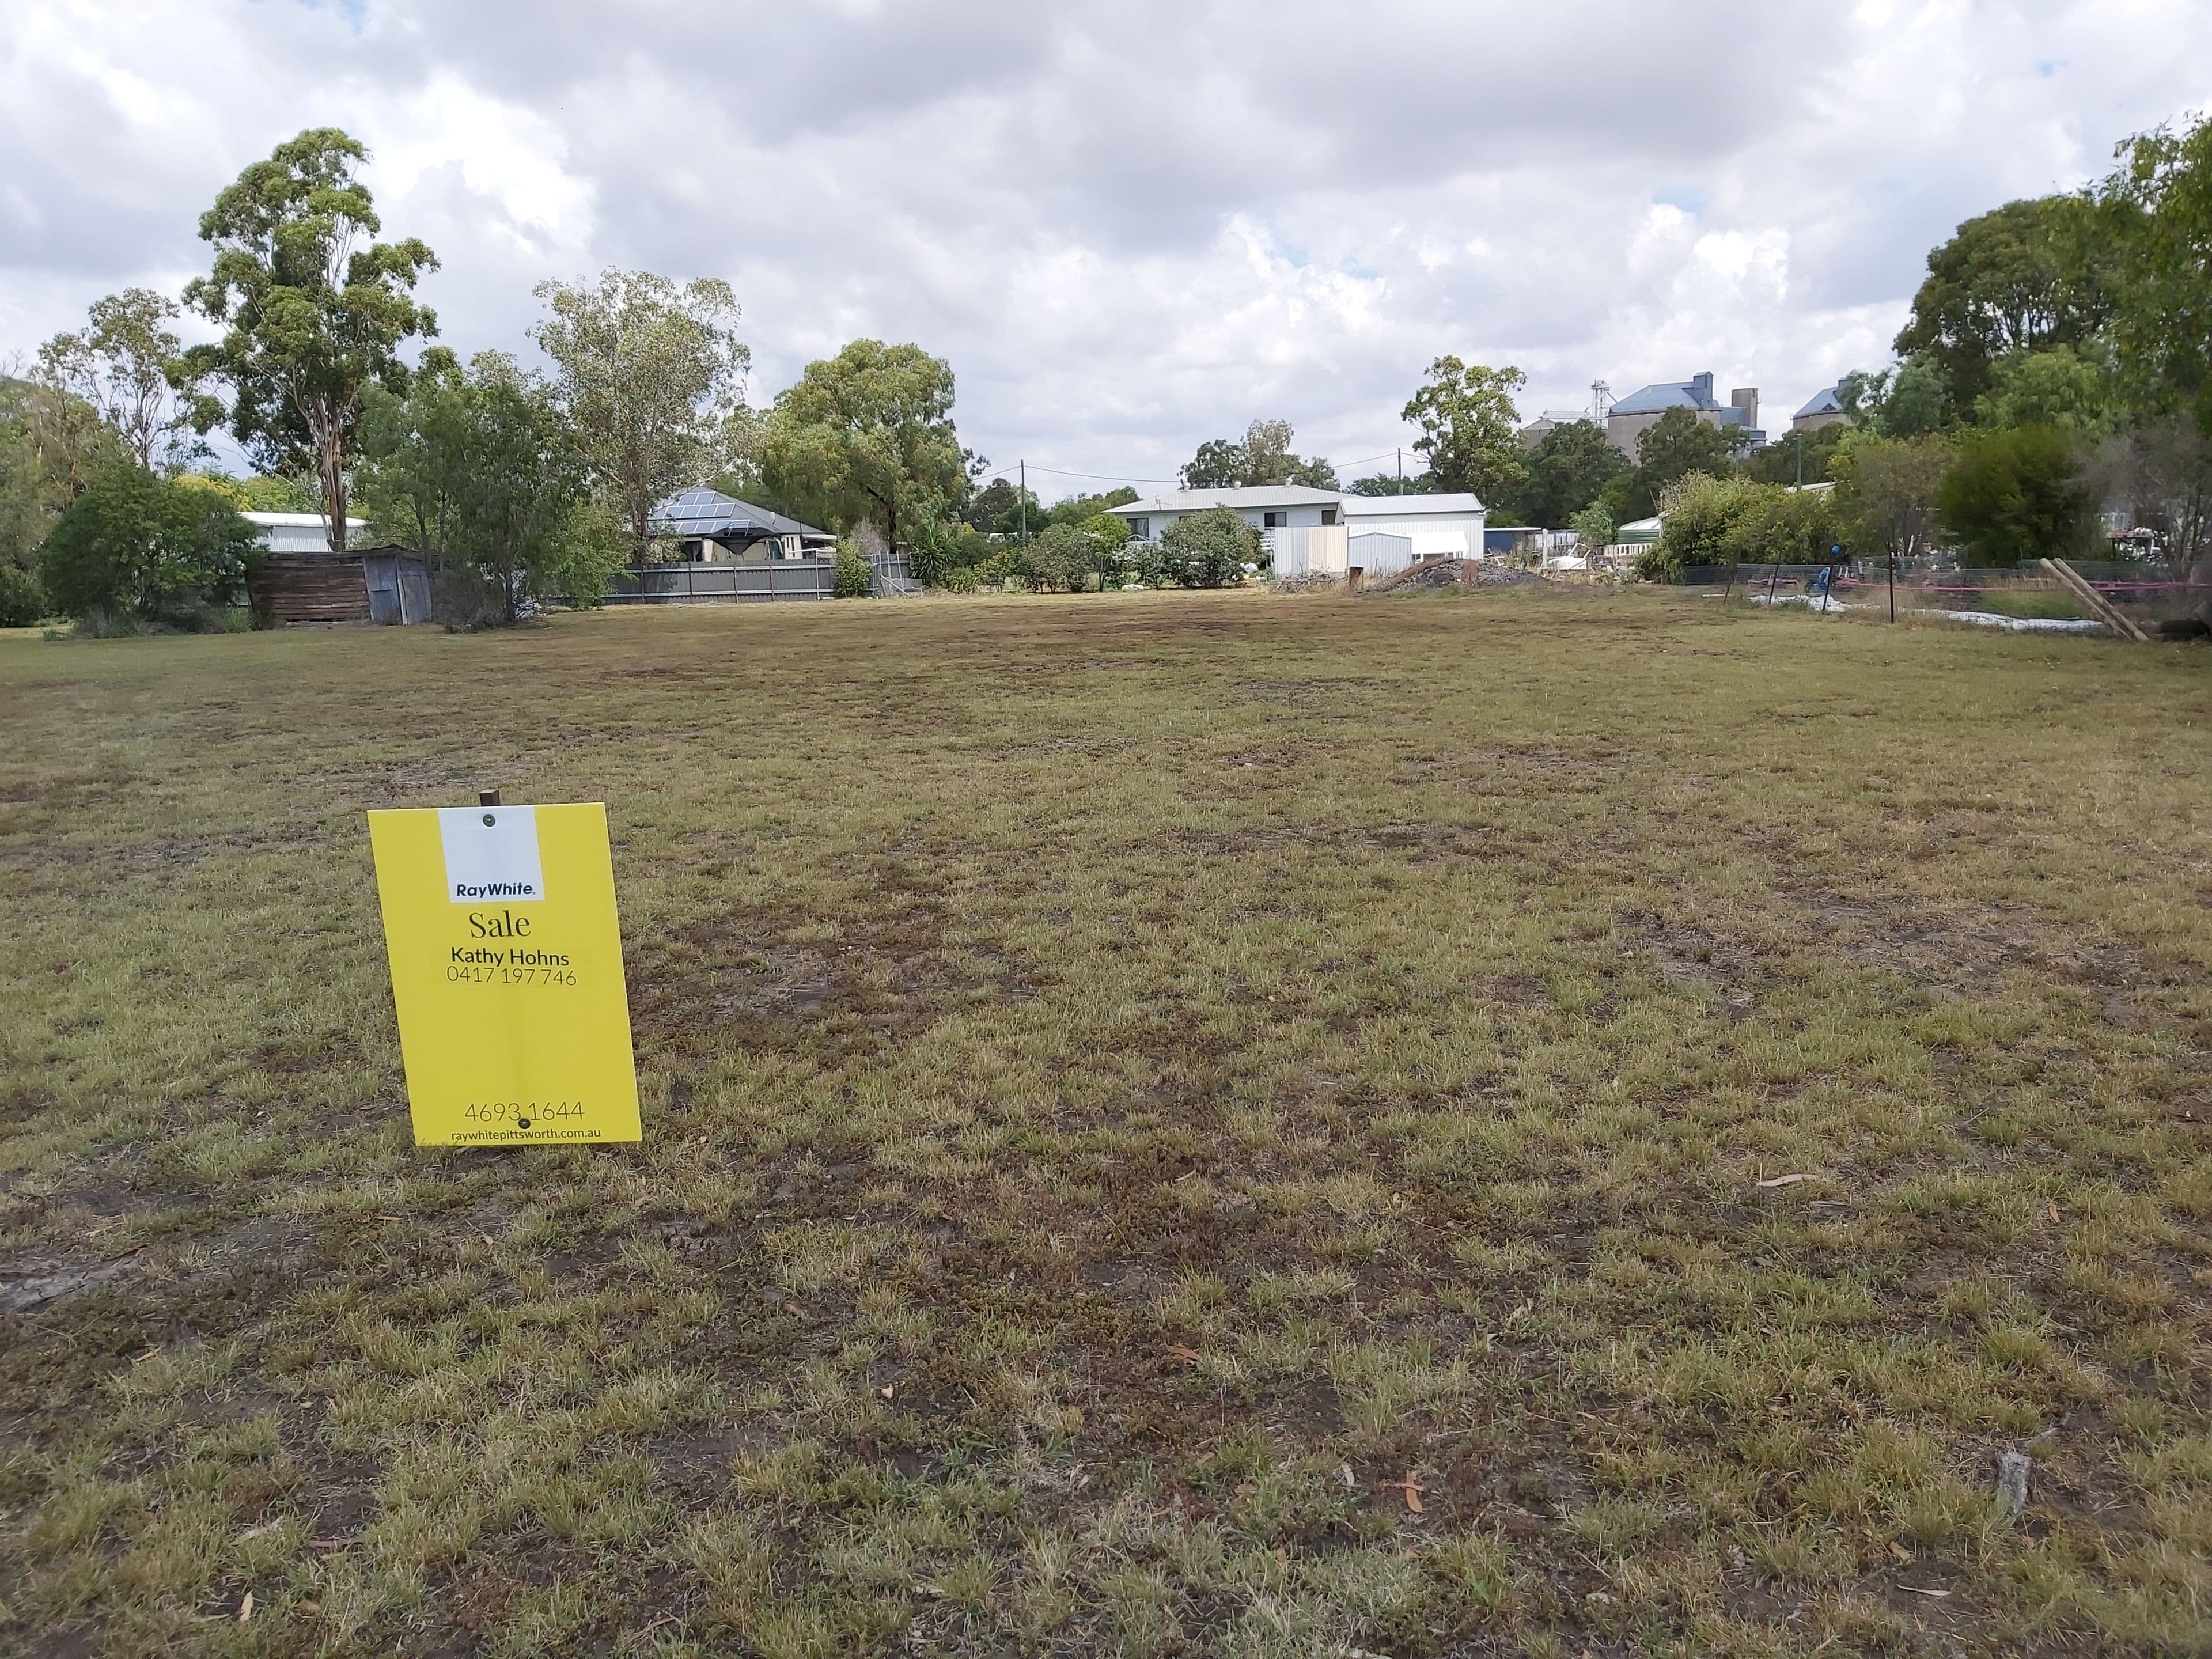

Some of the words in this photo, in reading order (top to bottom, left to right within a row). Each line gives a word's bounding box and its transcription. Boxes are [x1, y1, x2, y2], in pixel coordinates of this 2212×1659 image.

[469, 910, 531, 938] Sale
[452, 947, 504, 967] Kathy
[510, 949, 569, 966] Hohns
[446, 965, 494, 983] 0417
[501, 968, 535, 984] 197
[541, 969, 577, 986] 746
[464, 1103, 521, 1122] 4693
[528, 1101, 585, 1120] 1644
[451, 1128, 601, 1142] raywhitepittsworth.com.au
